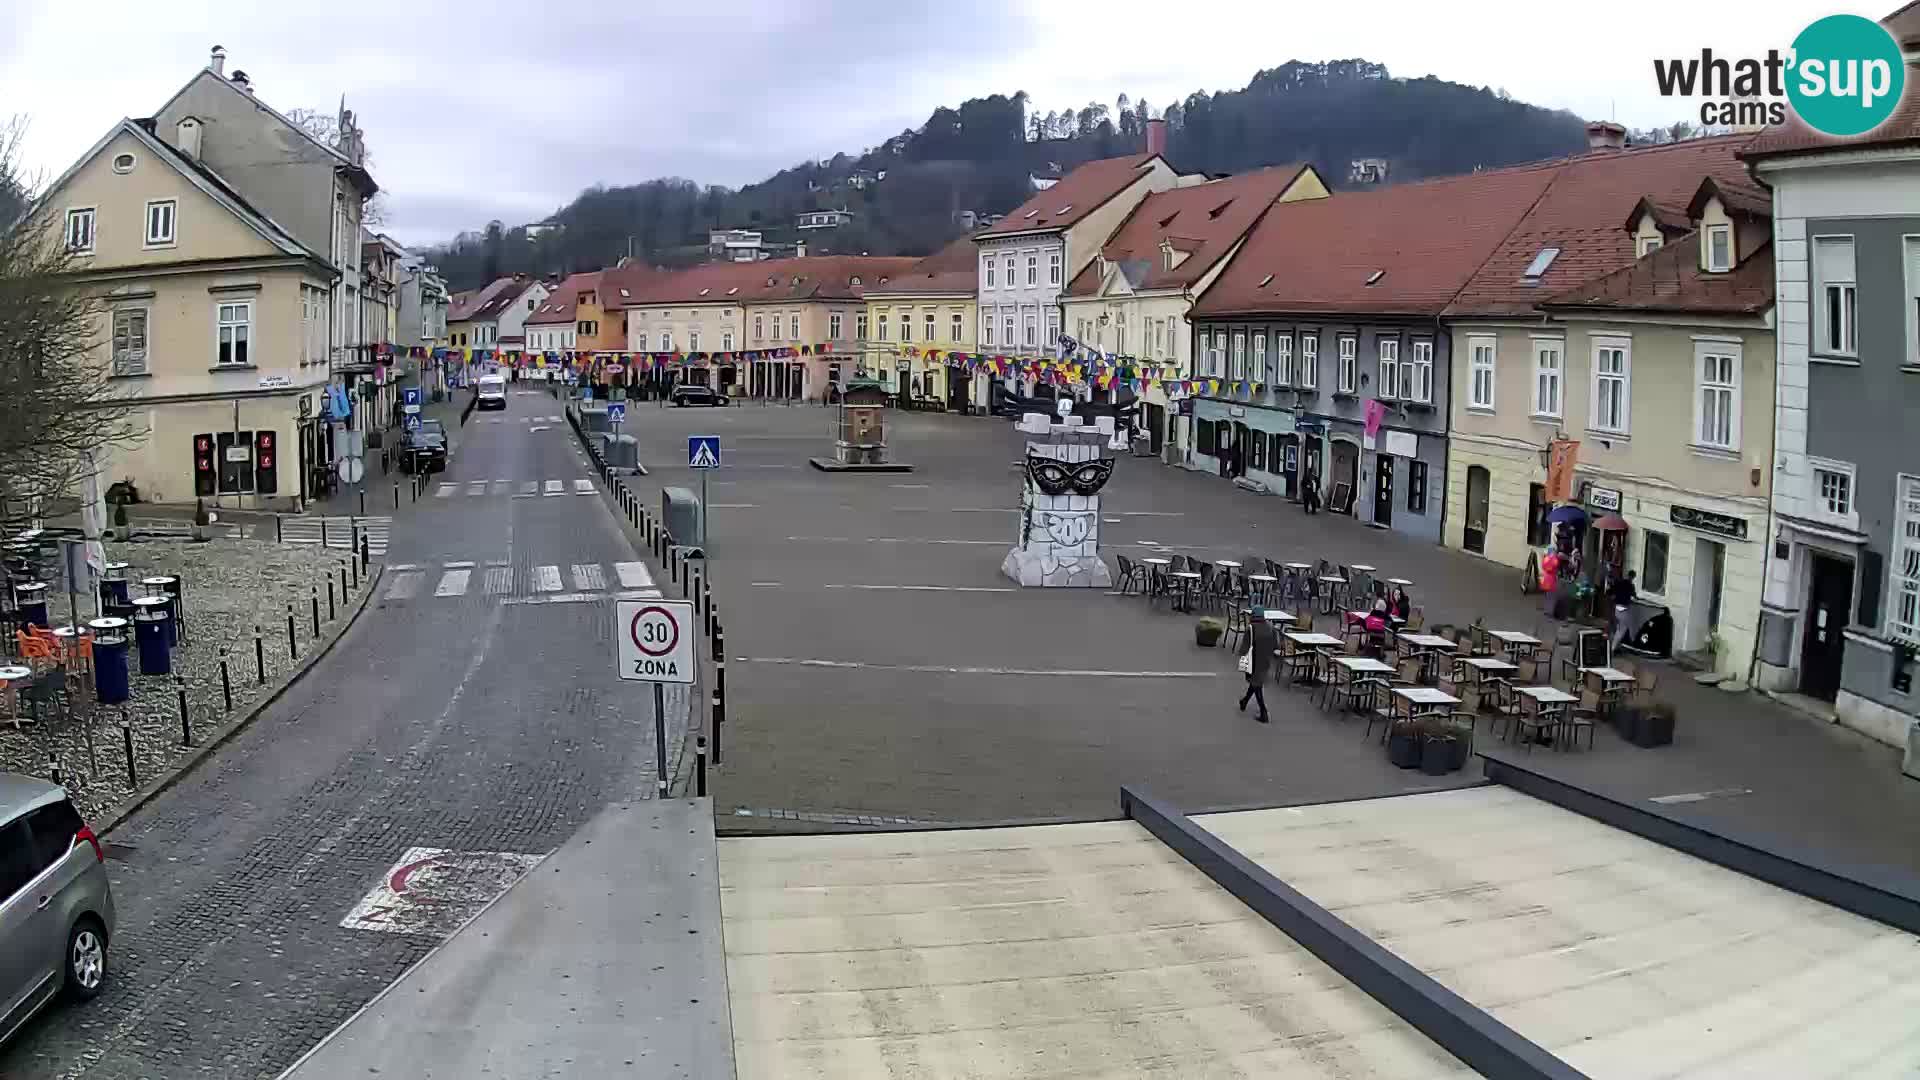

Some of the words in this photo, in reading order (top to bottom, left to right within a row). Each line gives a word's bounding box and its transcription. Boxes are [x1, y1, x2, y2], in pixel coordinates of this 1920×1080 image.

[408, 391, 416, 403] P
[643, 622, 668, 643] 30
[633, 659, 678, 677] ZONA
